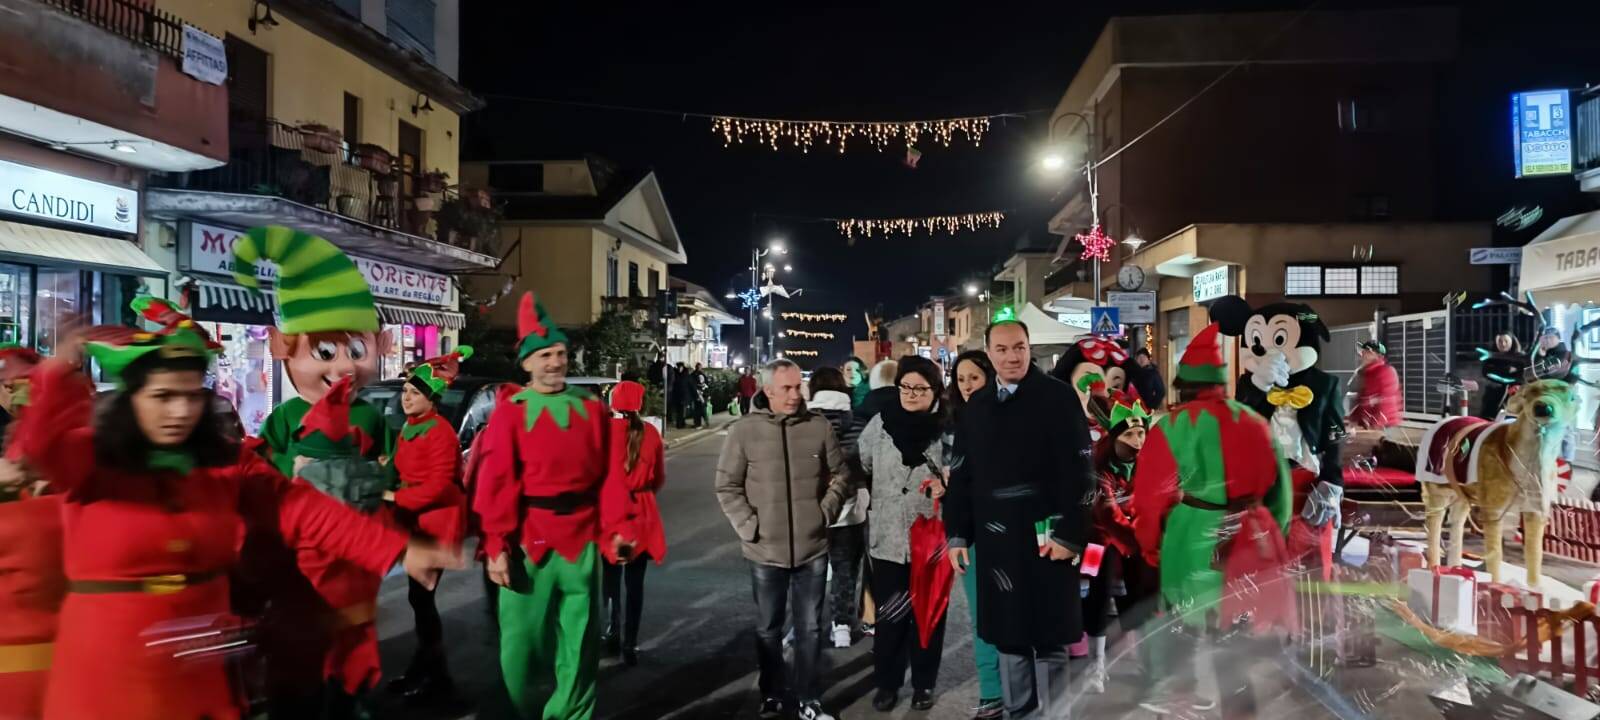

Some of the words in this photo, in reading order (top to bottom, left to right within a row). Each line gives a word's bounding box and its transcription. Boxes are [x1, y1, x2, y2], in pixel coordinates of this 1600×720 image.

[1523, 129, 1569, 138] TABACCHI
[12, 188, 95, 223] CANDIDI
[1555, 246, 1600, 272] TABA
[413, 290, 441, 302] REGALO
